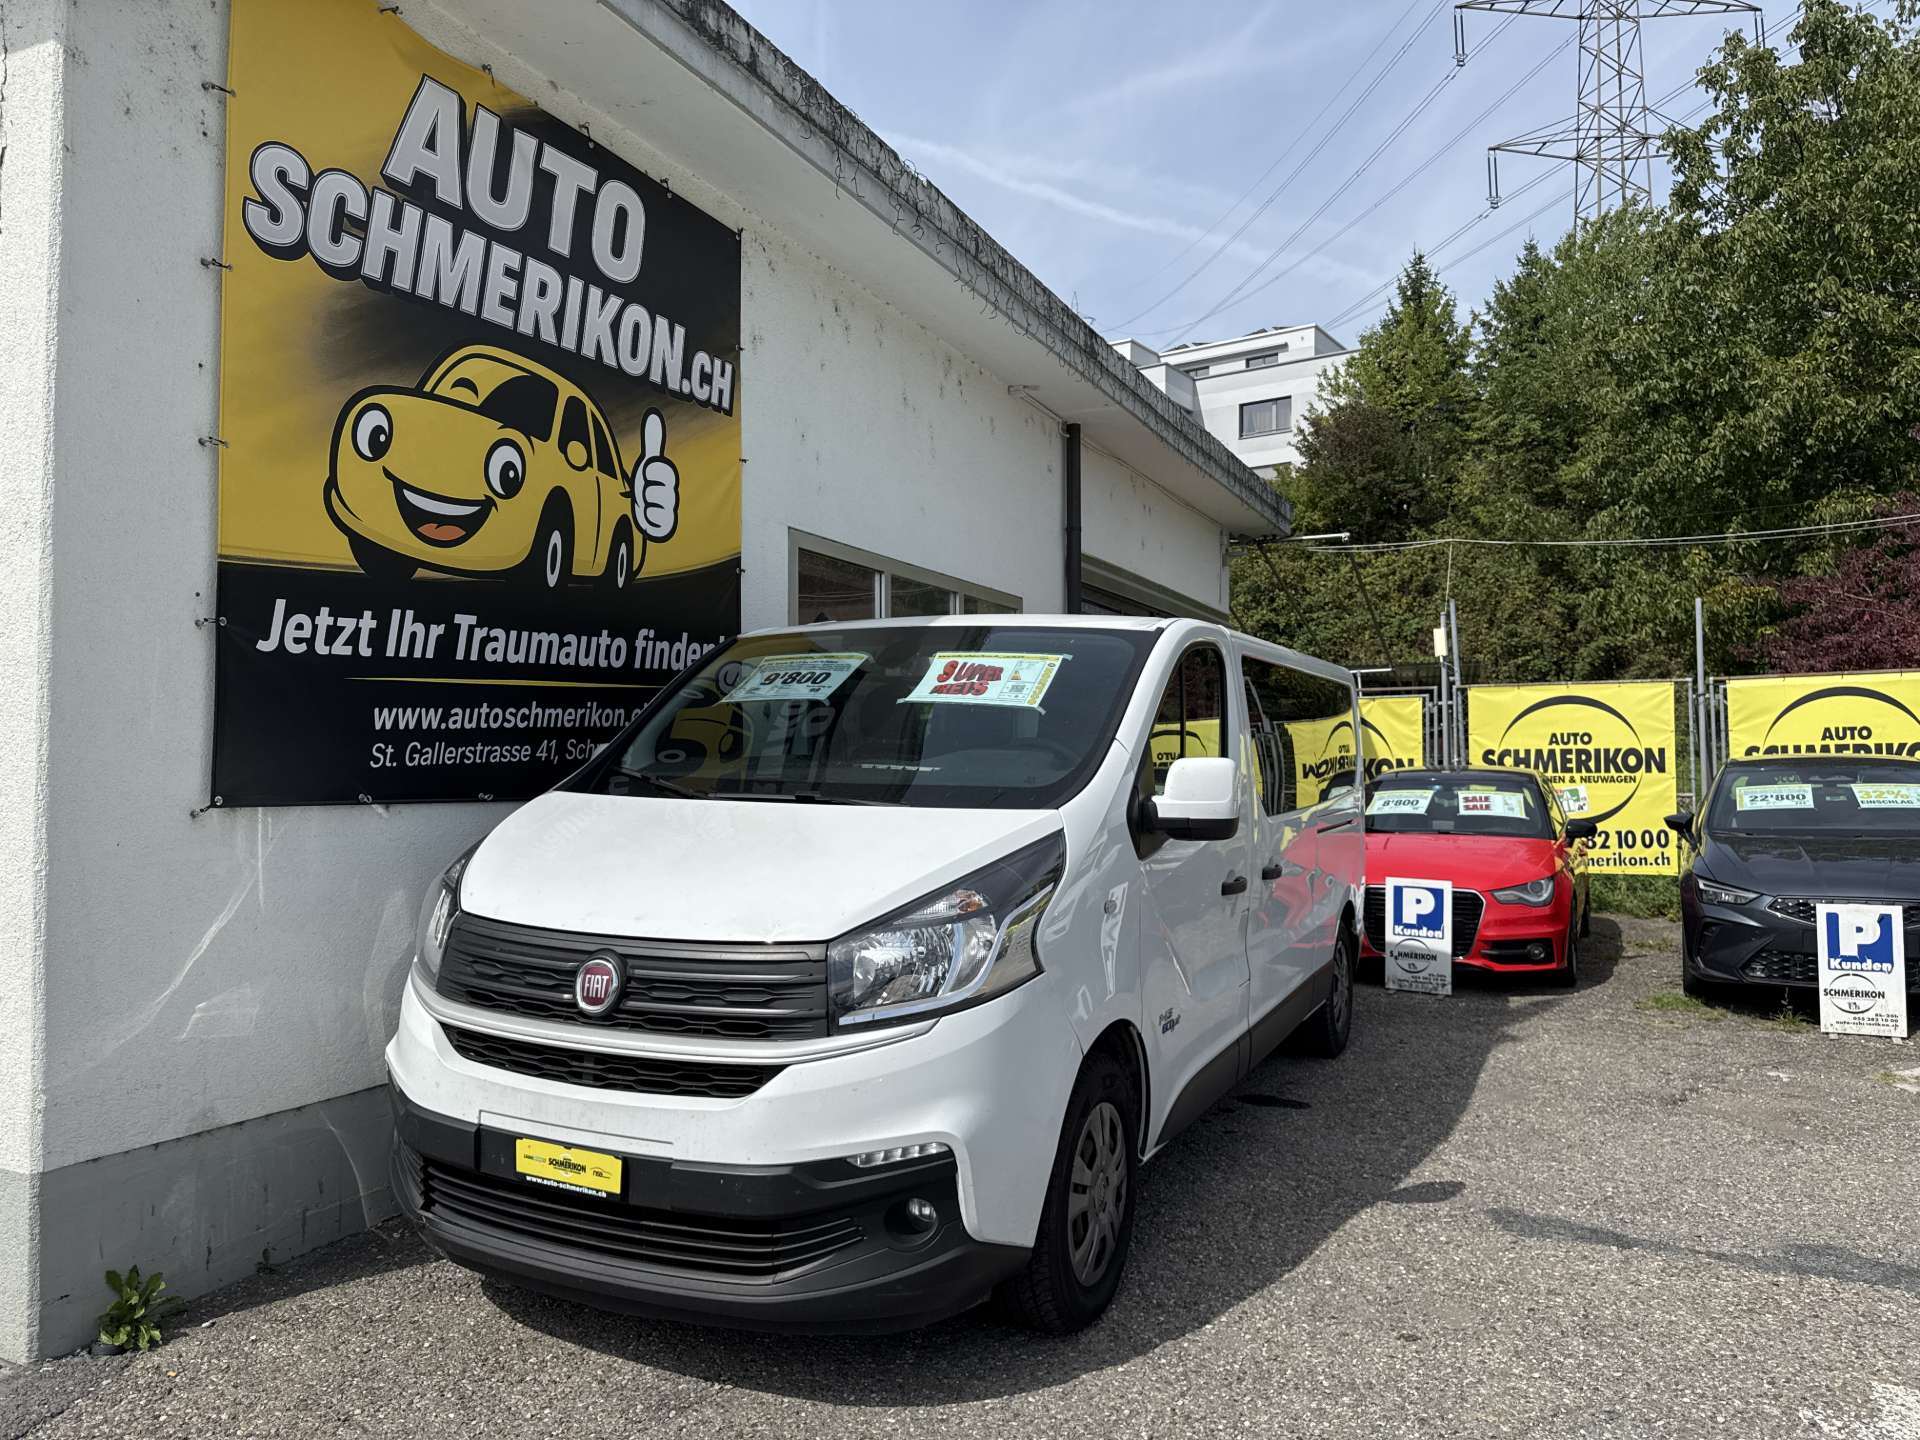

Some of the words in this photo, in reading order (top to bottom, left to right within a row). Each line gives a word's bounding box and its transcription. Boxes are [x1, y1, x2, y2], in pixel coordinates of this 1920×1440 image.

[382, 74, 646, 284] AUTO
[245, 142, 734, 411] SCHMERIKON.CH
[256, 599, 377, 657] Jetzt
[386, 609, 445, 659] Ihr
[454, 614, 627, 668] Traumauto
[634, 628, 725, 670] finde
[760, 671, 831, 685] 9'800
[374, 701, 647, 730] www.autoschmerikon.c
[1549, 732, 1592, 745] AUTO
[1821, 726, 1872, 741] AUTO
[370, 743, 396, 767] St.
[405, 739, 531, 766] Gallerstrasse
[535, 739, 558, 764] 41,
[1482, 748, 1666, 774] SCHMERIKON
[1580, 775, 1636, 783] NEUWAGEN
[1382, 799, 1419, 807] 8'800
[1750, 793, 1806, 802] 22'800
[1463, 803, 1492, 811] SALE
[1402, 887, 1435, 924] P
[1394, 925, 1443, 938] Kunden
[1839, 910, 1881, 955] P
[1830, 958, 1892, 971] Kunden
[584, 974, 609, 998] FIAT
[1823, 988, 1886, 999] SCHMERIKON
[548, 1157, 586, 1173] SCHMERIKON
